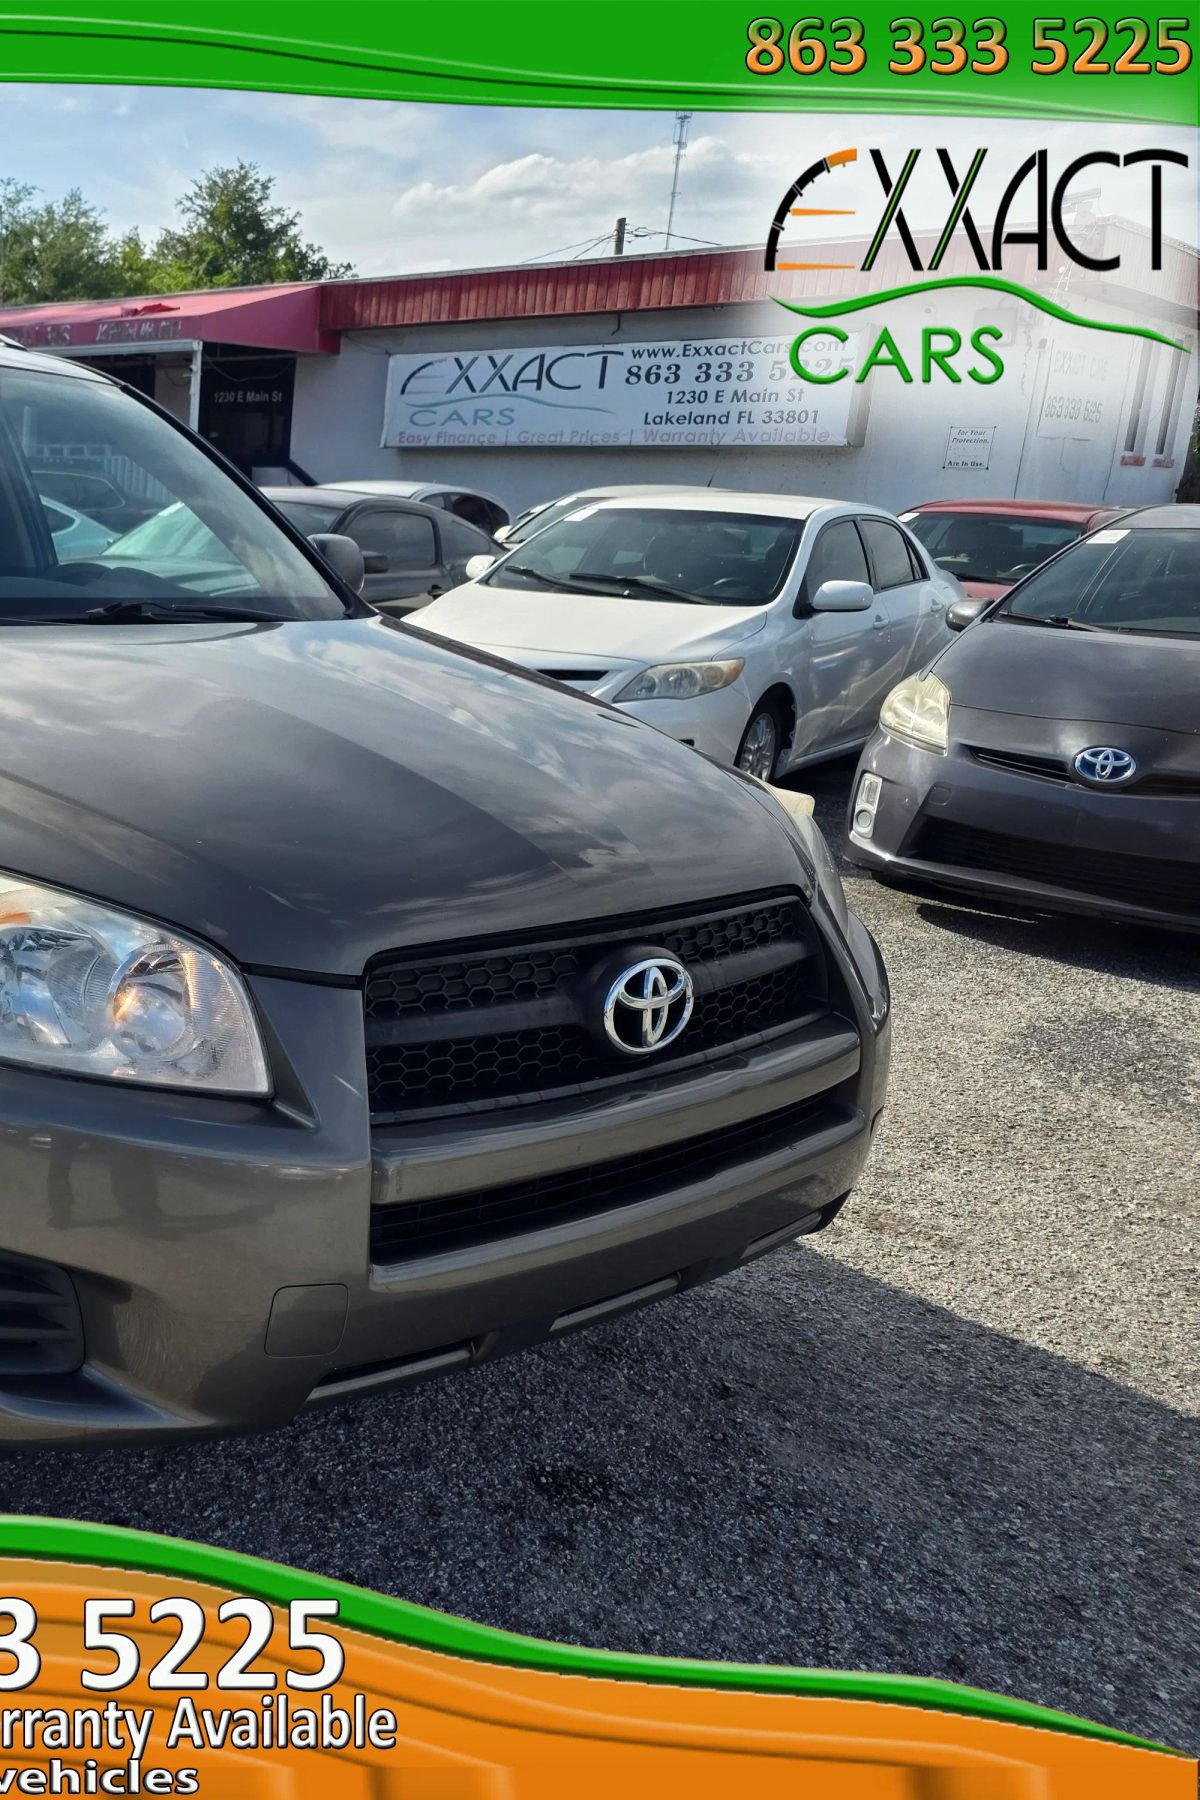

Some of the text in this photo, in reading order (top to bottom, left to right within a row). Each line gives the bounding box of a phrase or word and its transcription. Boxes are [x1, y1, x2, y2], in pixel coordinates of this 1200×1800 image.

[632, 339, 847, 359] www.ExxactCarscom
[400, 350, 624, 395] EXXACT
[625, 363, 681, 385] 863
[694, 361, 755, 383] 333
[214, 390, 282, 403] 1230 E Main St
[666, 388, 804, 405] 1230 E Main St
[409, 408, 516, 427] CARS
[643, 409, 819, 425] Lakeland FL 33801
[398, 428, 829, 446] Easy Finance Great Prices Warranty Available
